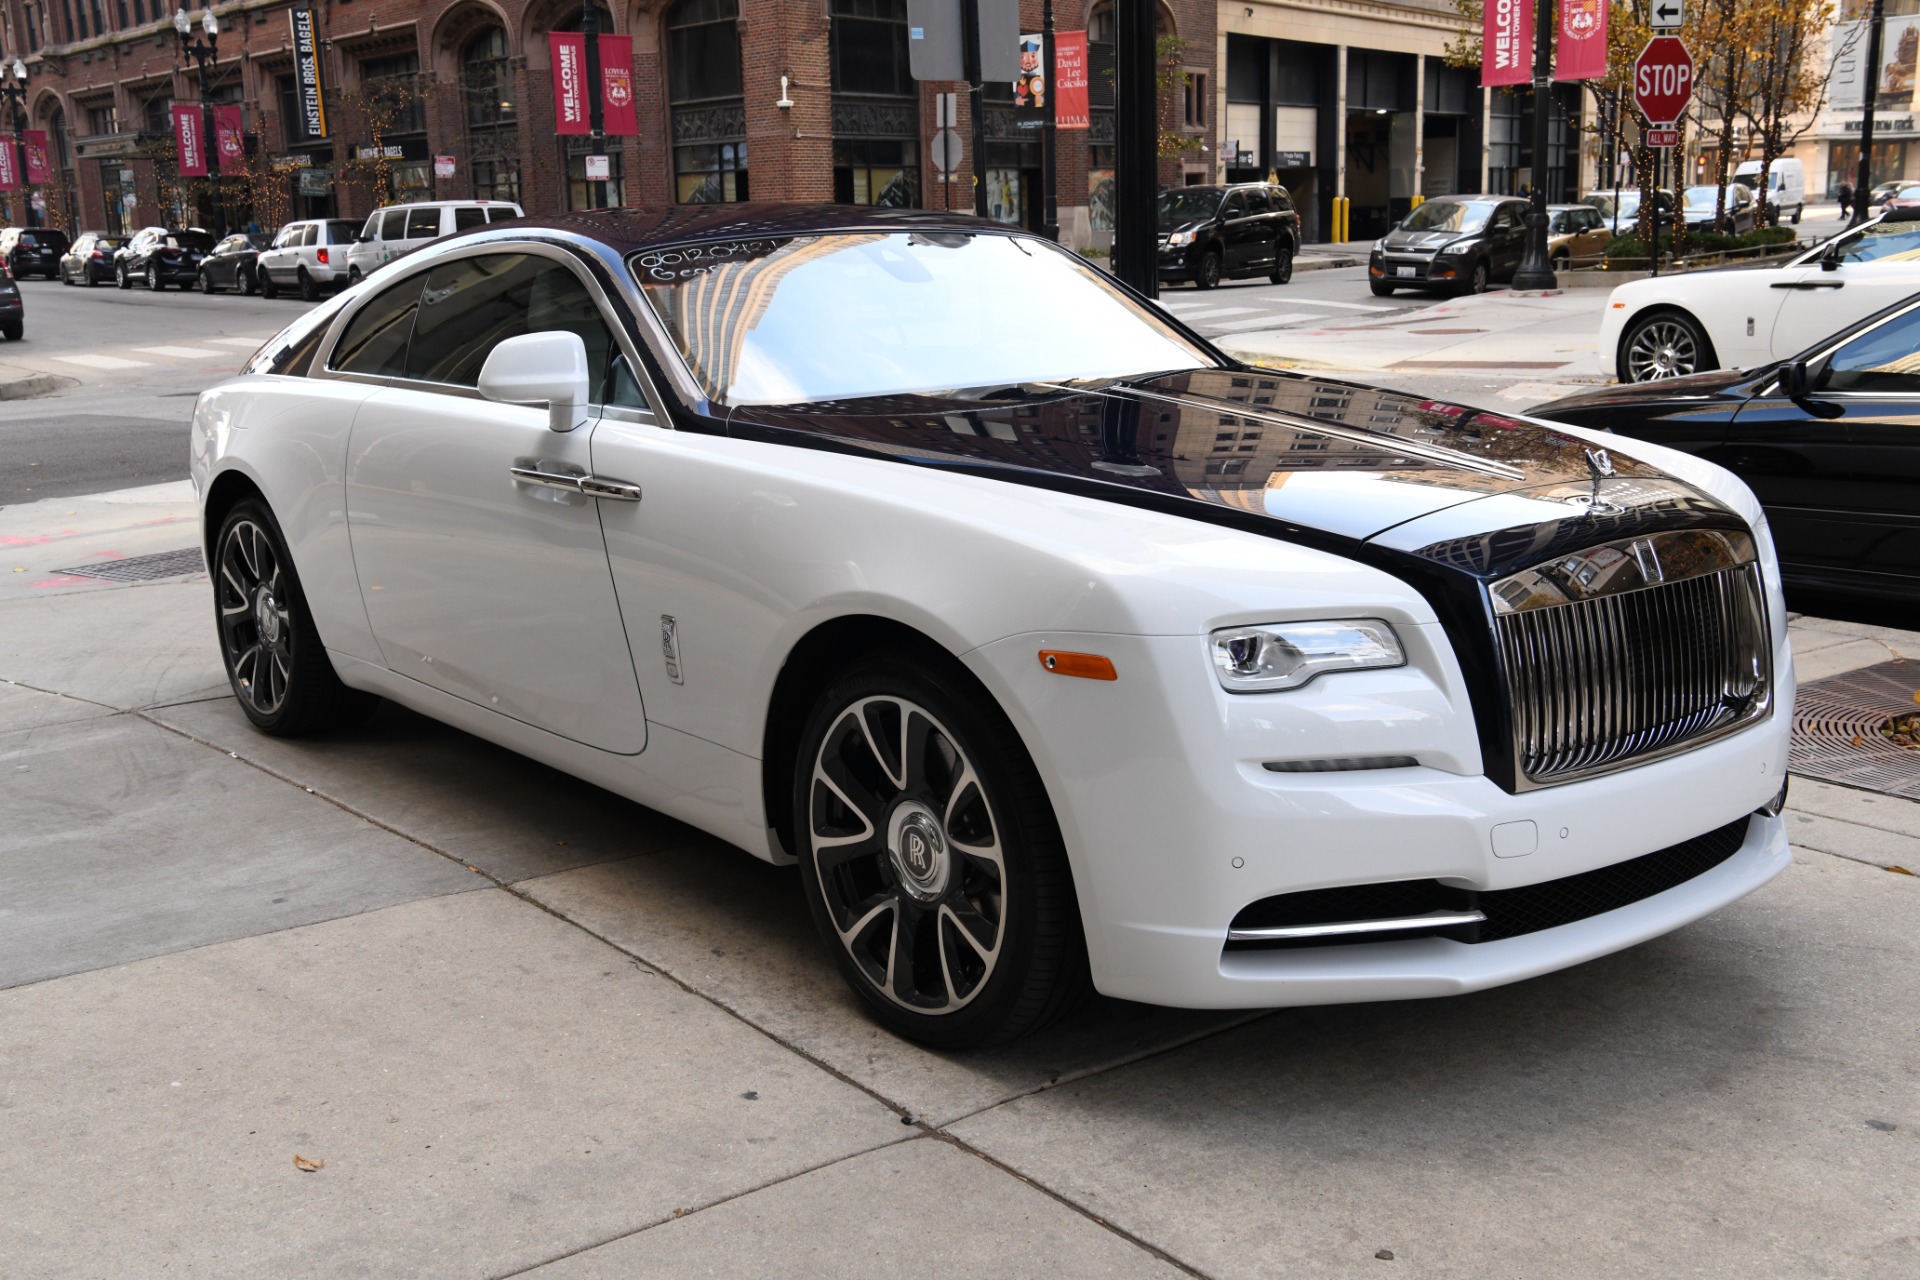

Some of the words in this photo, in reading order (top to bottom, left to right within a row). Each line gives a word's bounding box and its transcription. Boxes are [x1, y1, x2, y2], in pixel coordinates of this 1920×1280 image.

[297, 11, 313, 52] BAGELS
[1513, 6, 1521, 38] TOWER
[570, 46, 578, 74] CAMPUS
[1057, 57, 1081, 69] David
[1511, 39, 1520, 68] WATER
[559, 45, 575, 122] WELCOME
[604, 67, 630, 75] LOYOLA
[1056, 77, 1088, 89] Csicsko
[1067, 68, 1082, 78] Lee
[1638, 63, 1690, 97] STOP
[305, 87, 321, 135] EINSTEIN
[1055, 114, 1090, 127] LUMA
[180, 114, 194, 168] WELCOME
[384, 145, 403, 157] BAGELS
[1650, 133, 1662, 144] ALL
[1663, 133, 1676, 143] WAY
